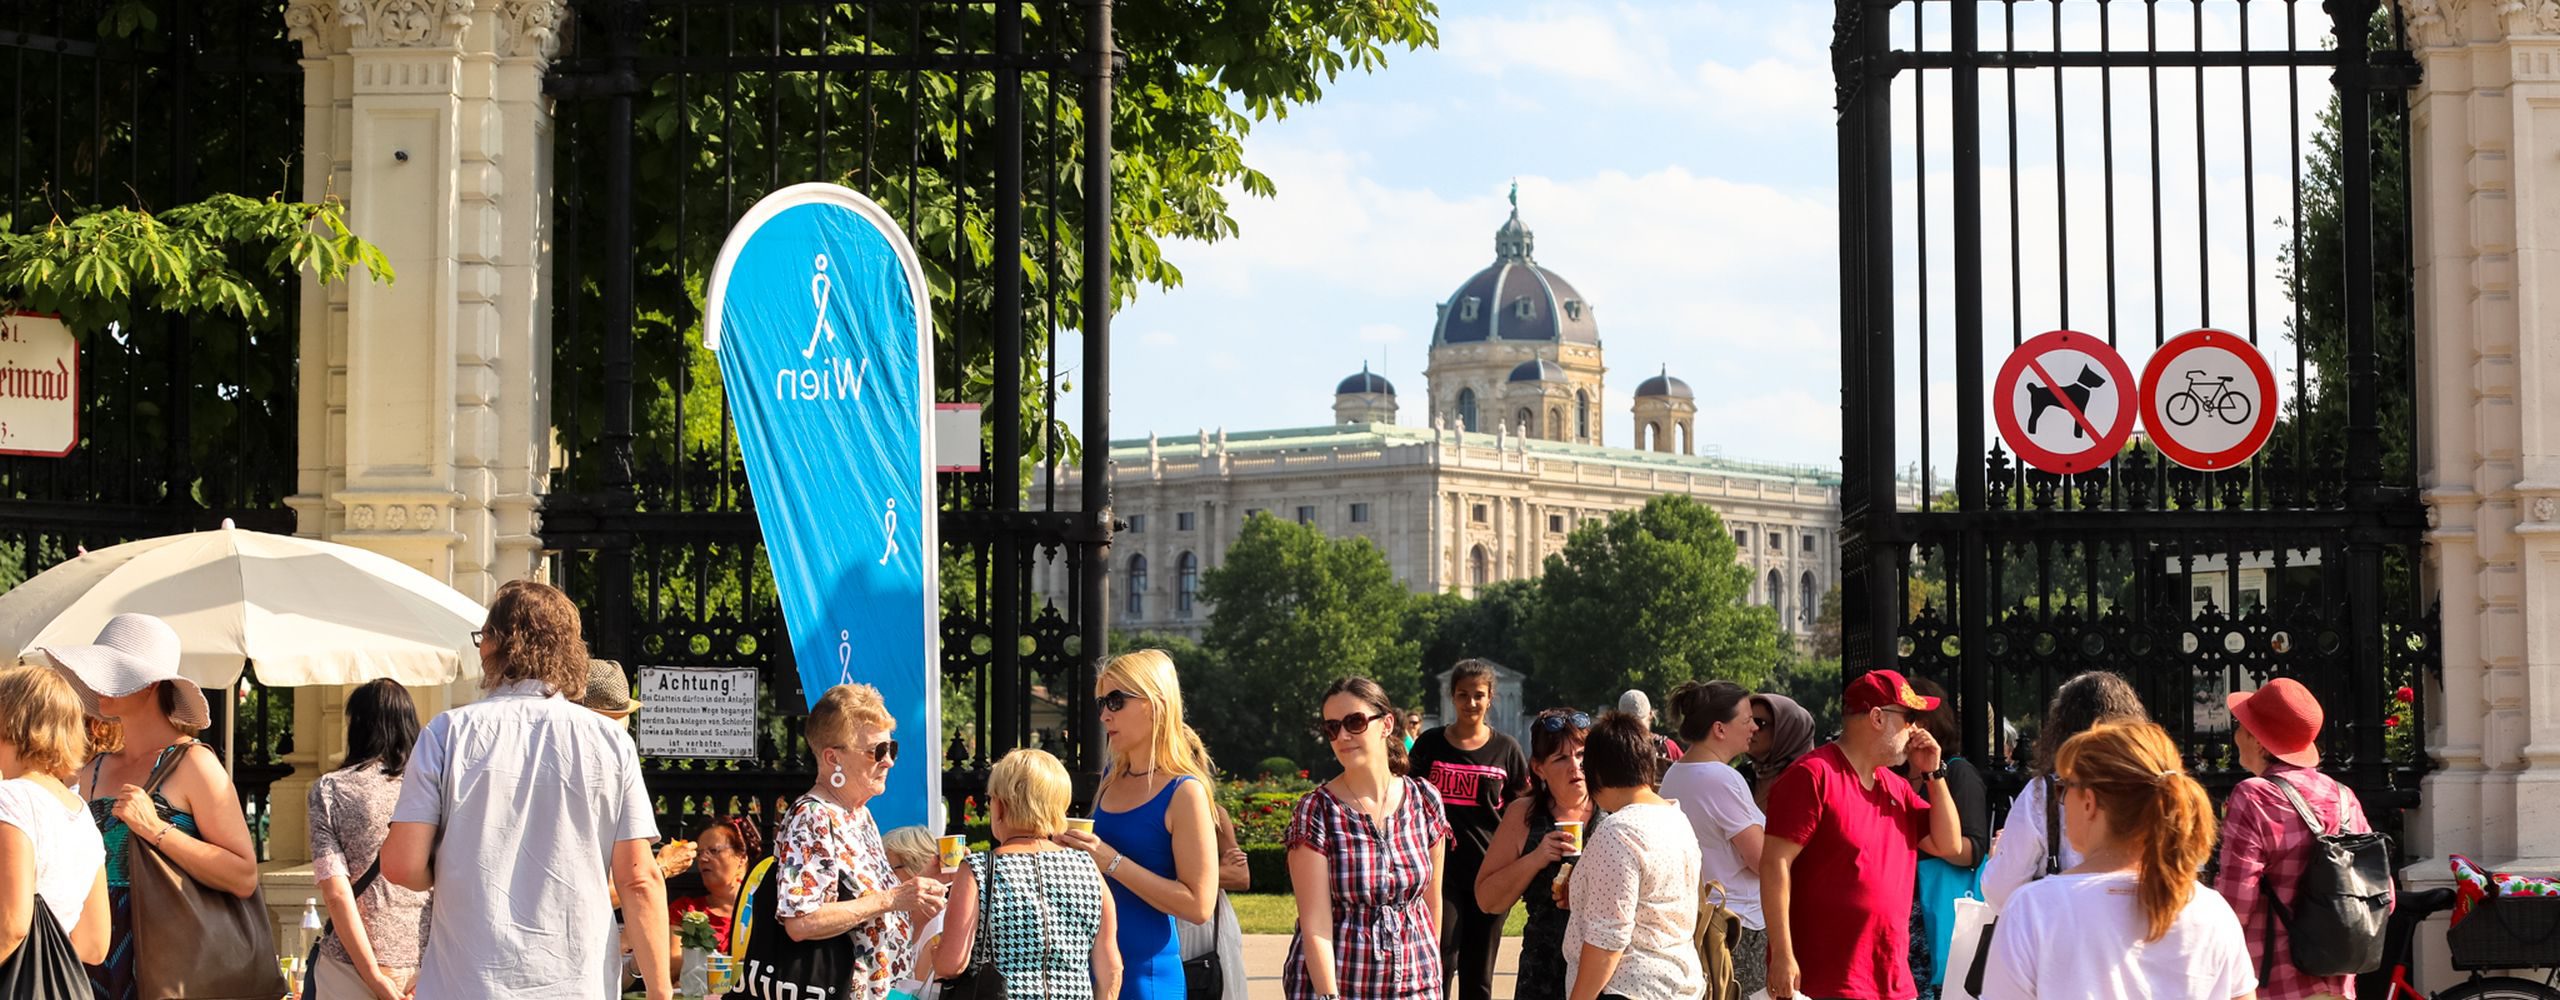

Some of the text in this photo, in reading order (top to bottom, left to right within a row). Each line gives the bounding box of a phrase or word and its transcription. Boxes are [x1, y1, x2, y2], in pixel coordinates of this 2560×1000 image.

[658, 673, 736, 695] Achtung!
[728, 696, 754, 705] Anlagen
[702, 706, 718, 716] Wege
[720, 707, 752, 716] begangen
[667, 716, 679, 724] Das
[681, 717, 706, 726] Anlegen
[675, 728, 699, 736] Rodeln
